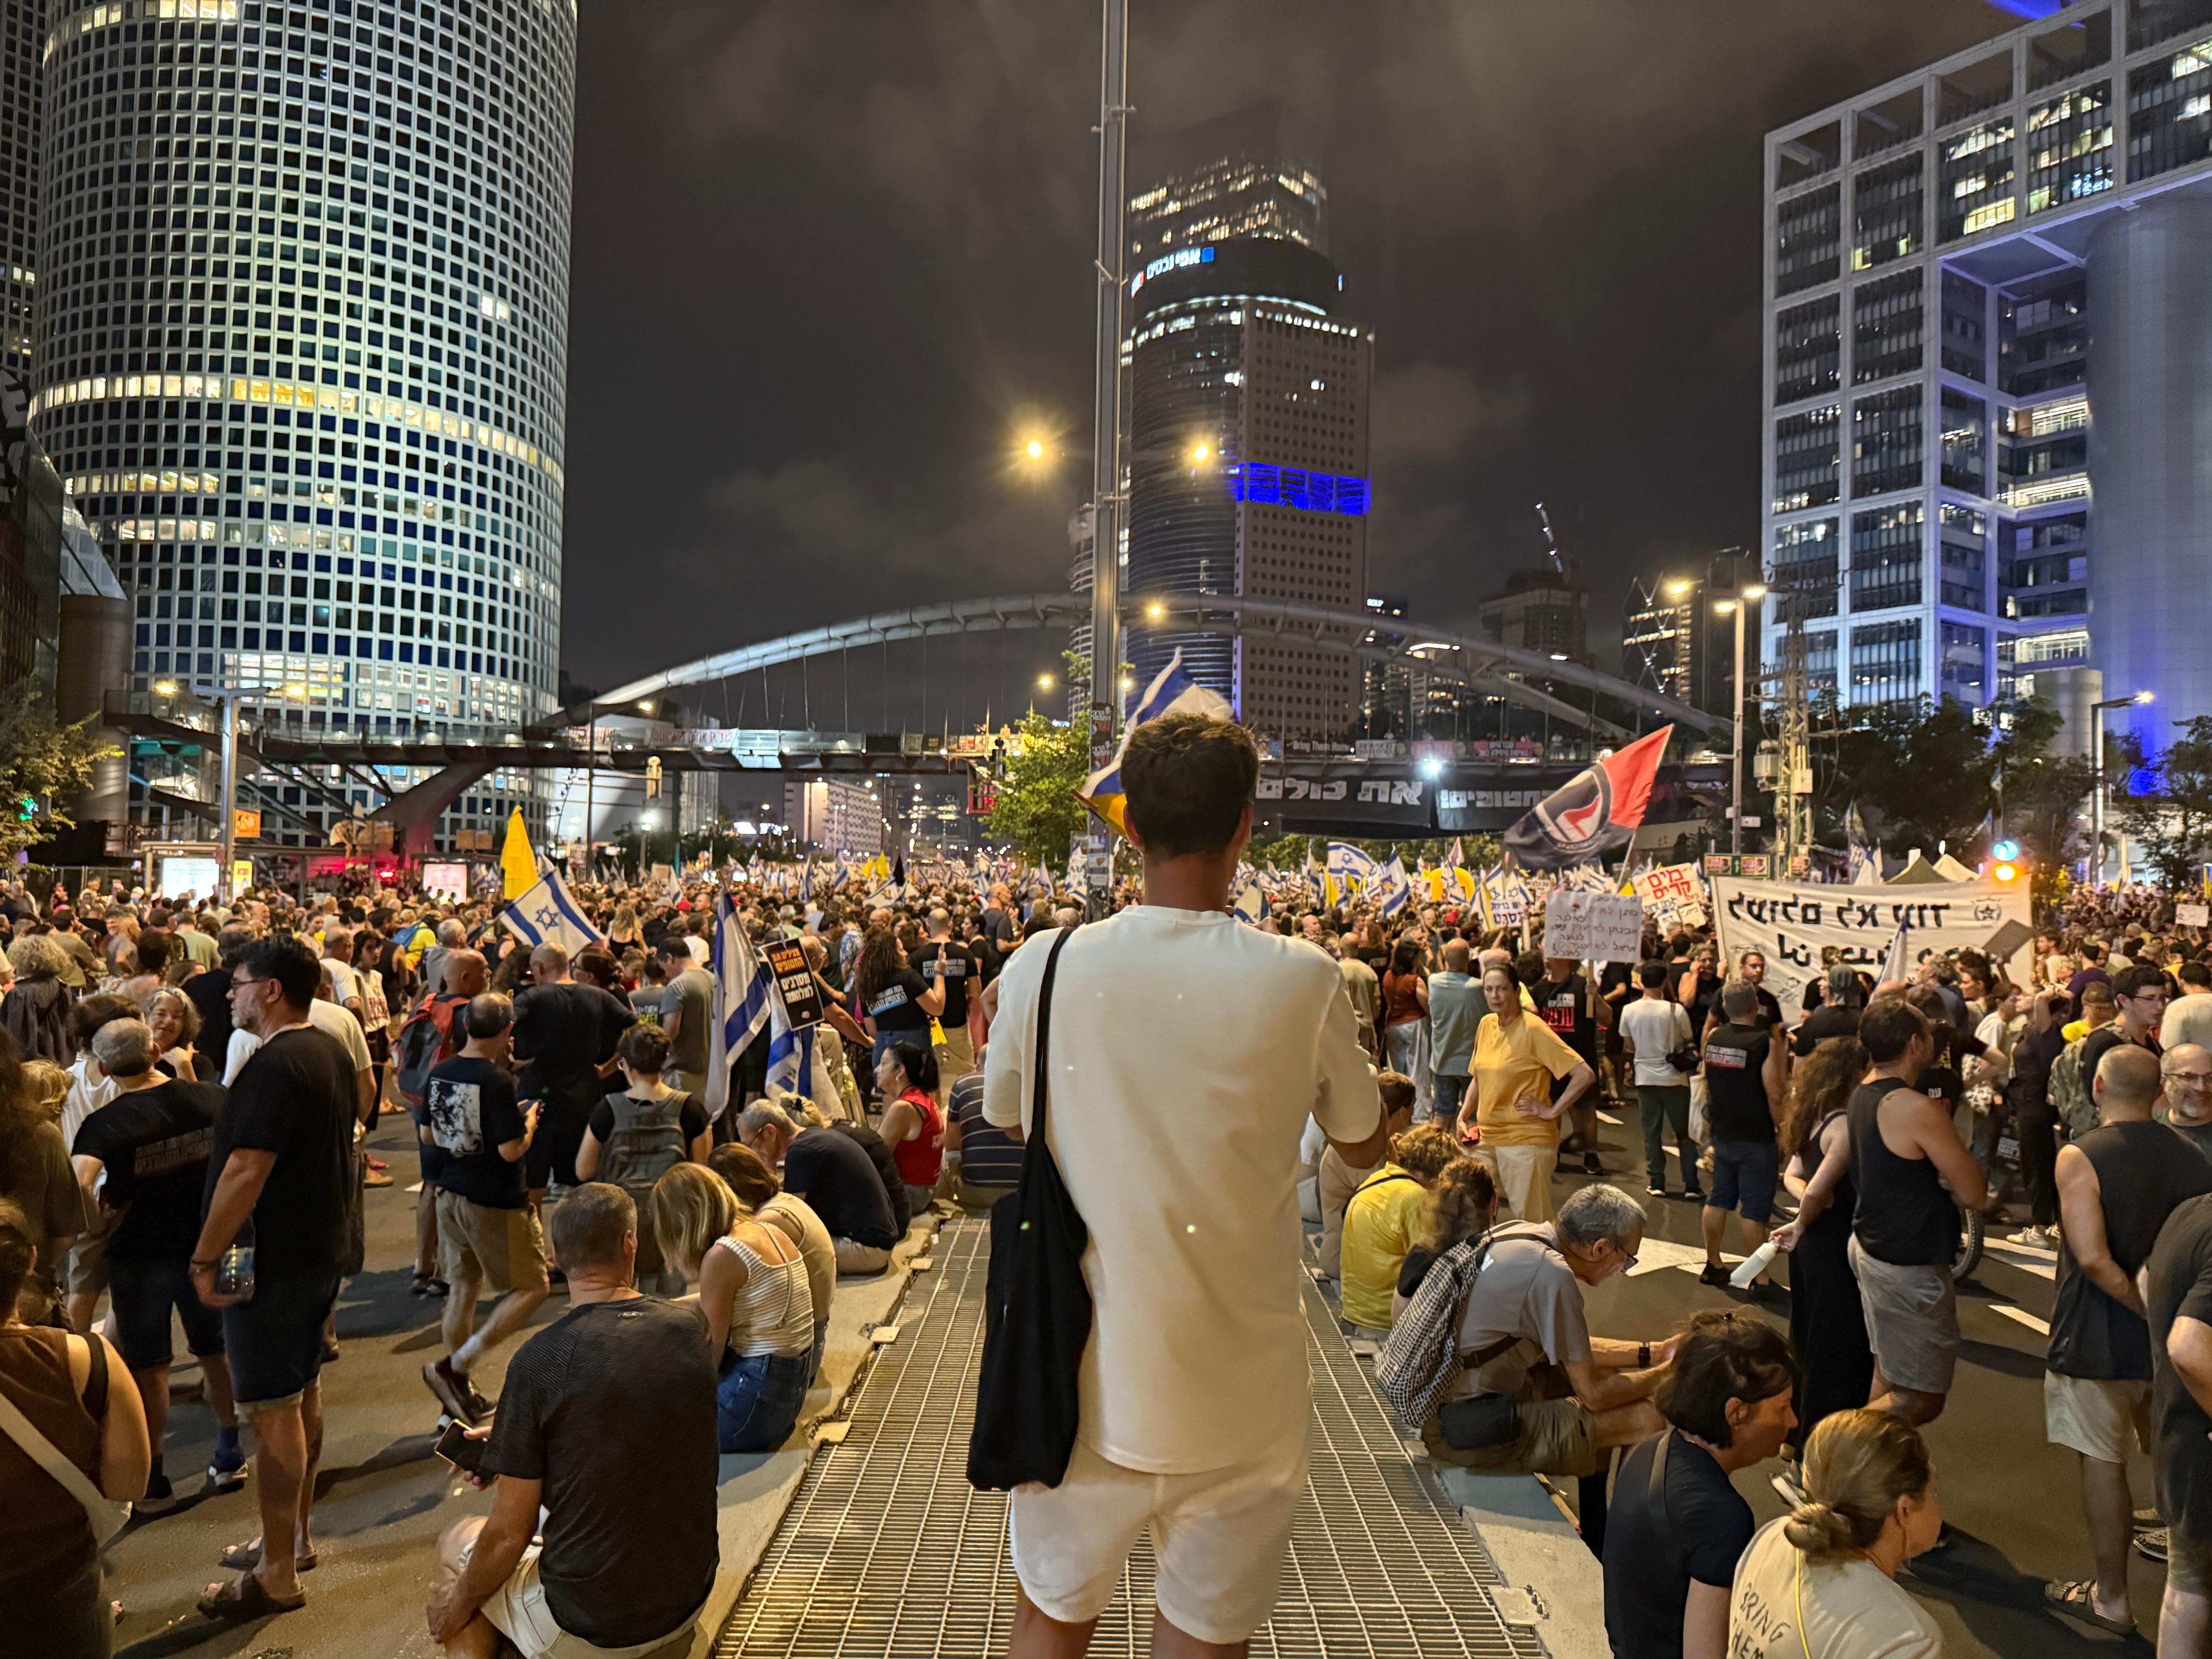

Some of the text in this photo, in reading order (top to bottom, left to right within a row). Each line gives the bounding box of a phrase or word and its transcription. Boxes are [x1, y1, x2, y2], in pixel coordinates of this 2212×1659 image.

[1146, 248, 1201, 280] אפי נכסים
[1293, 740, 1310, 752] Bring
[1312, 741, 1331, 751] Them
[1255, 777, 1423, 806] את כולם
[1647, 868, 1684, 888] מים
[1653, 881, 1691, 900] קרים
[780, 947, 801, 960] מצילים
[774, 957, 805, 973] החטופים
[780, 972, 811, 992] מסרבים
[785, 985, 814, 1004] למלחמה
[1732, 1616, 1764, 1659] HEM
